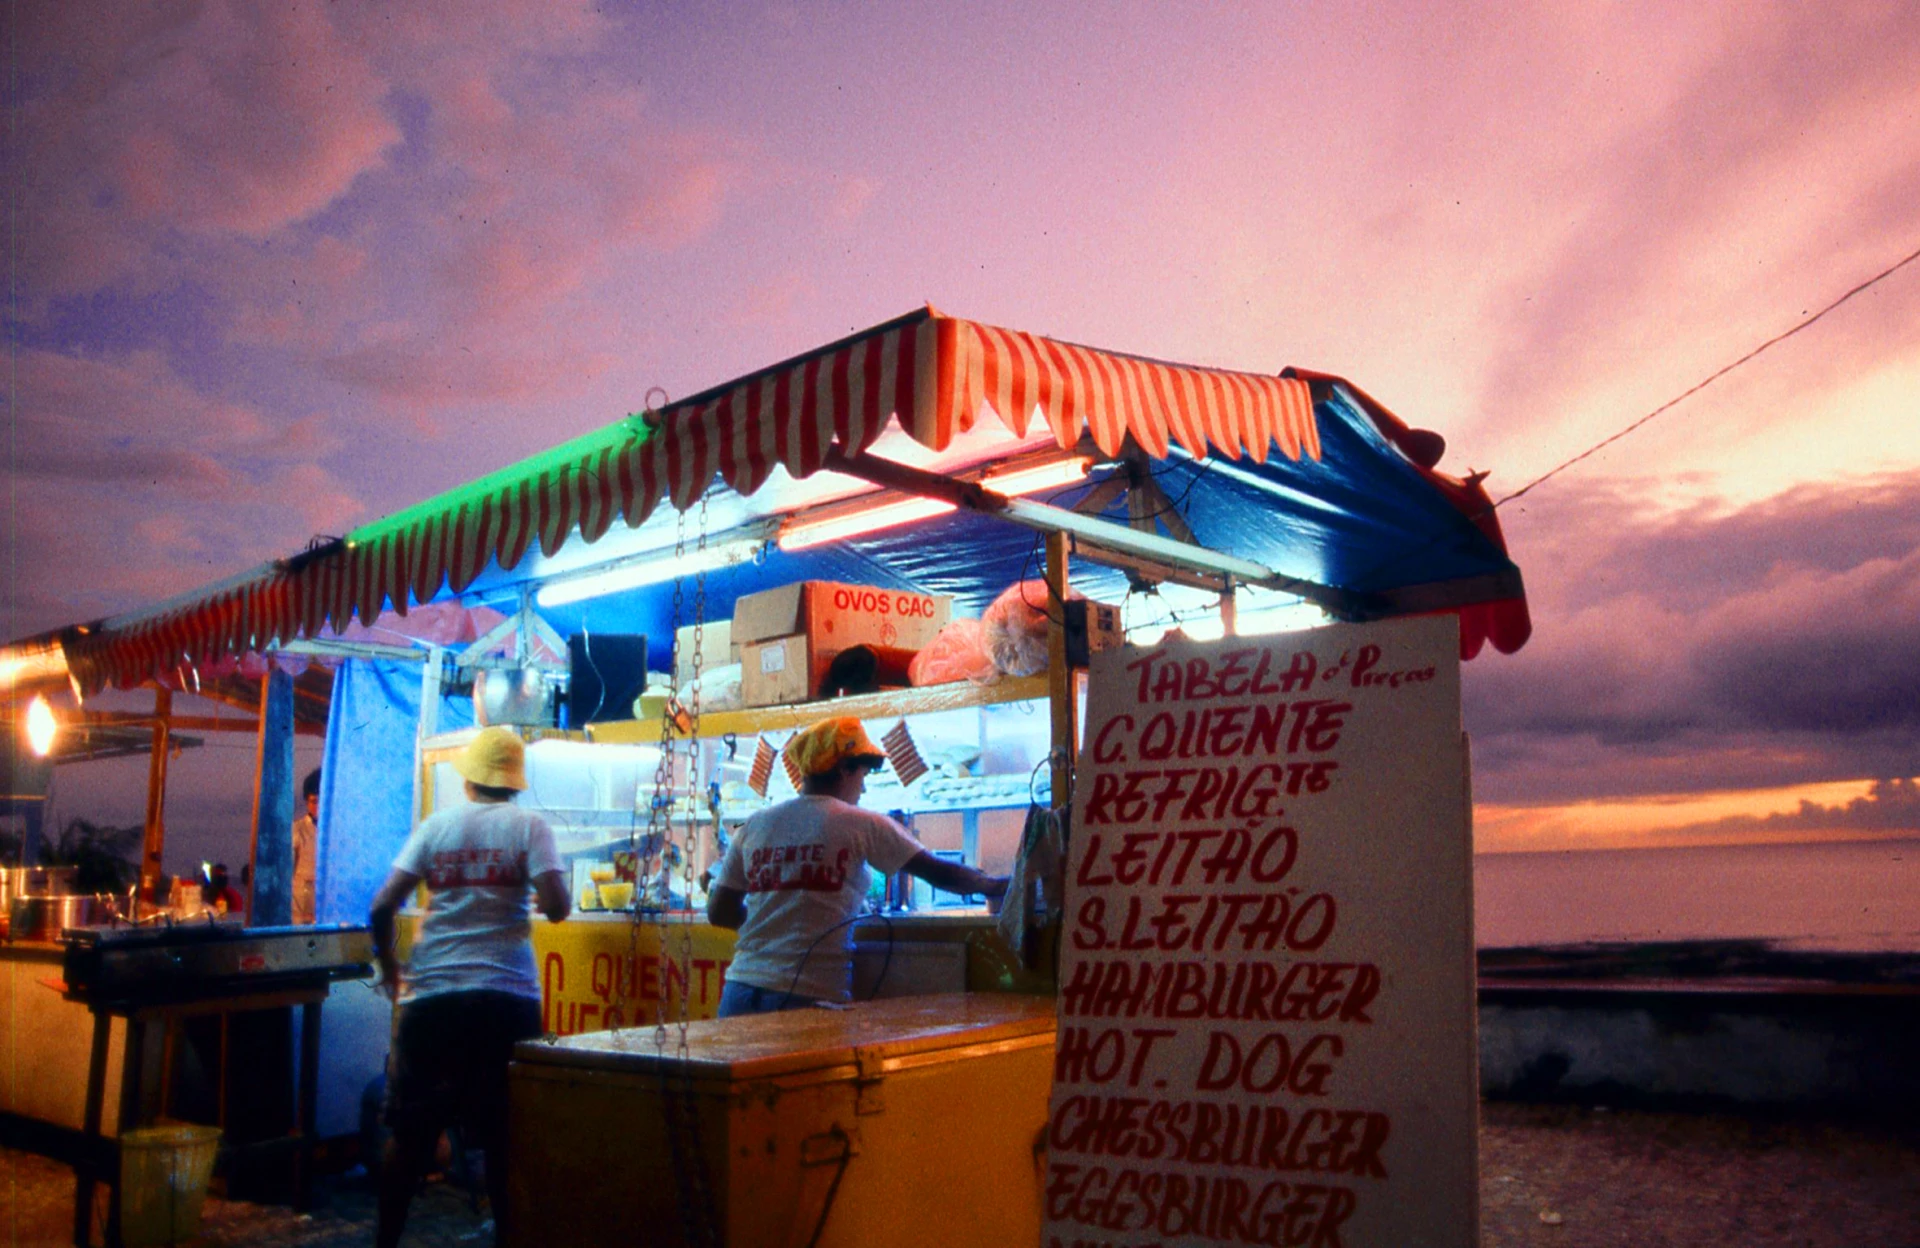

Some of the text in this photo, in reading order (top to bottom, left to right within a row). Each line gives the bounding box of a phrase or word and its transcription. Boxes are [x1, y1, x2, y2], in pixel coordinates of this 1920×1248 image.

[834, 589, 936, 619] OVOS CAC
[1126, 648, 1317, 703] TABELA
[1077, 819, 1298, 887] LEITÃO
[1063, 960, 1382, 1024] HAMBURGER
[1197, 1030, 1345, 1097] DOG
[1050, 1094, 1391, 1180] CHESSBURGER
[1046, 1164, 1357, 1248] EGGSBURGER
